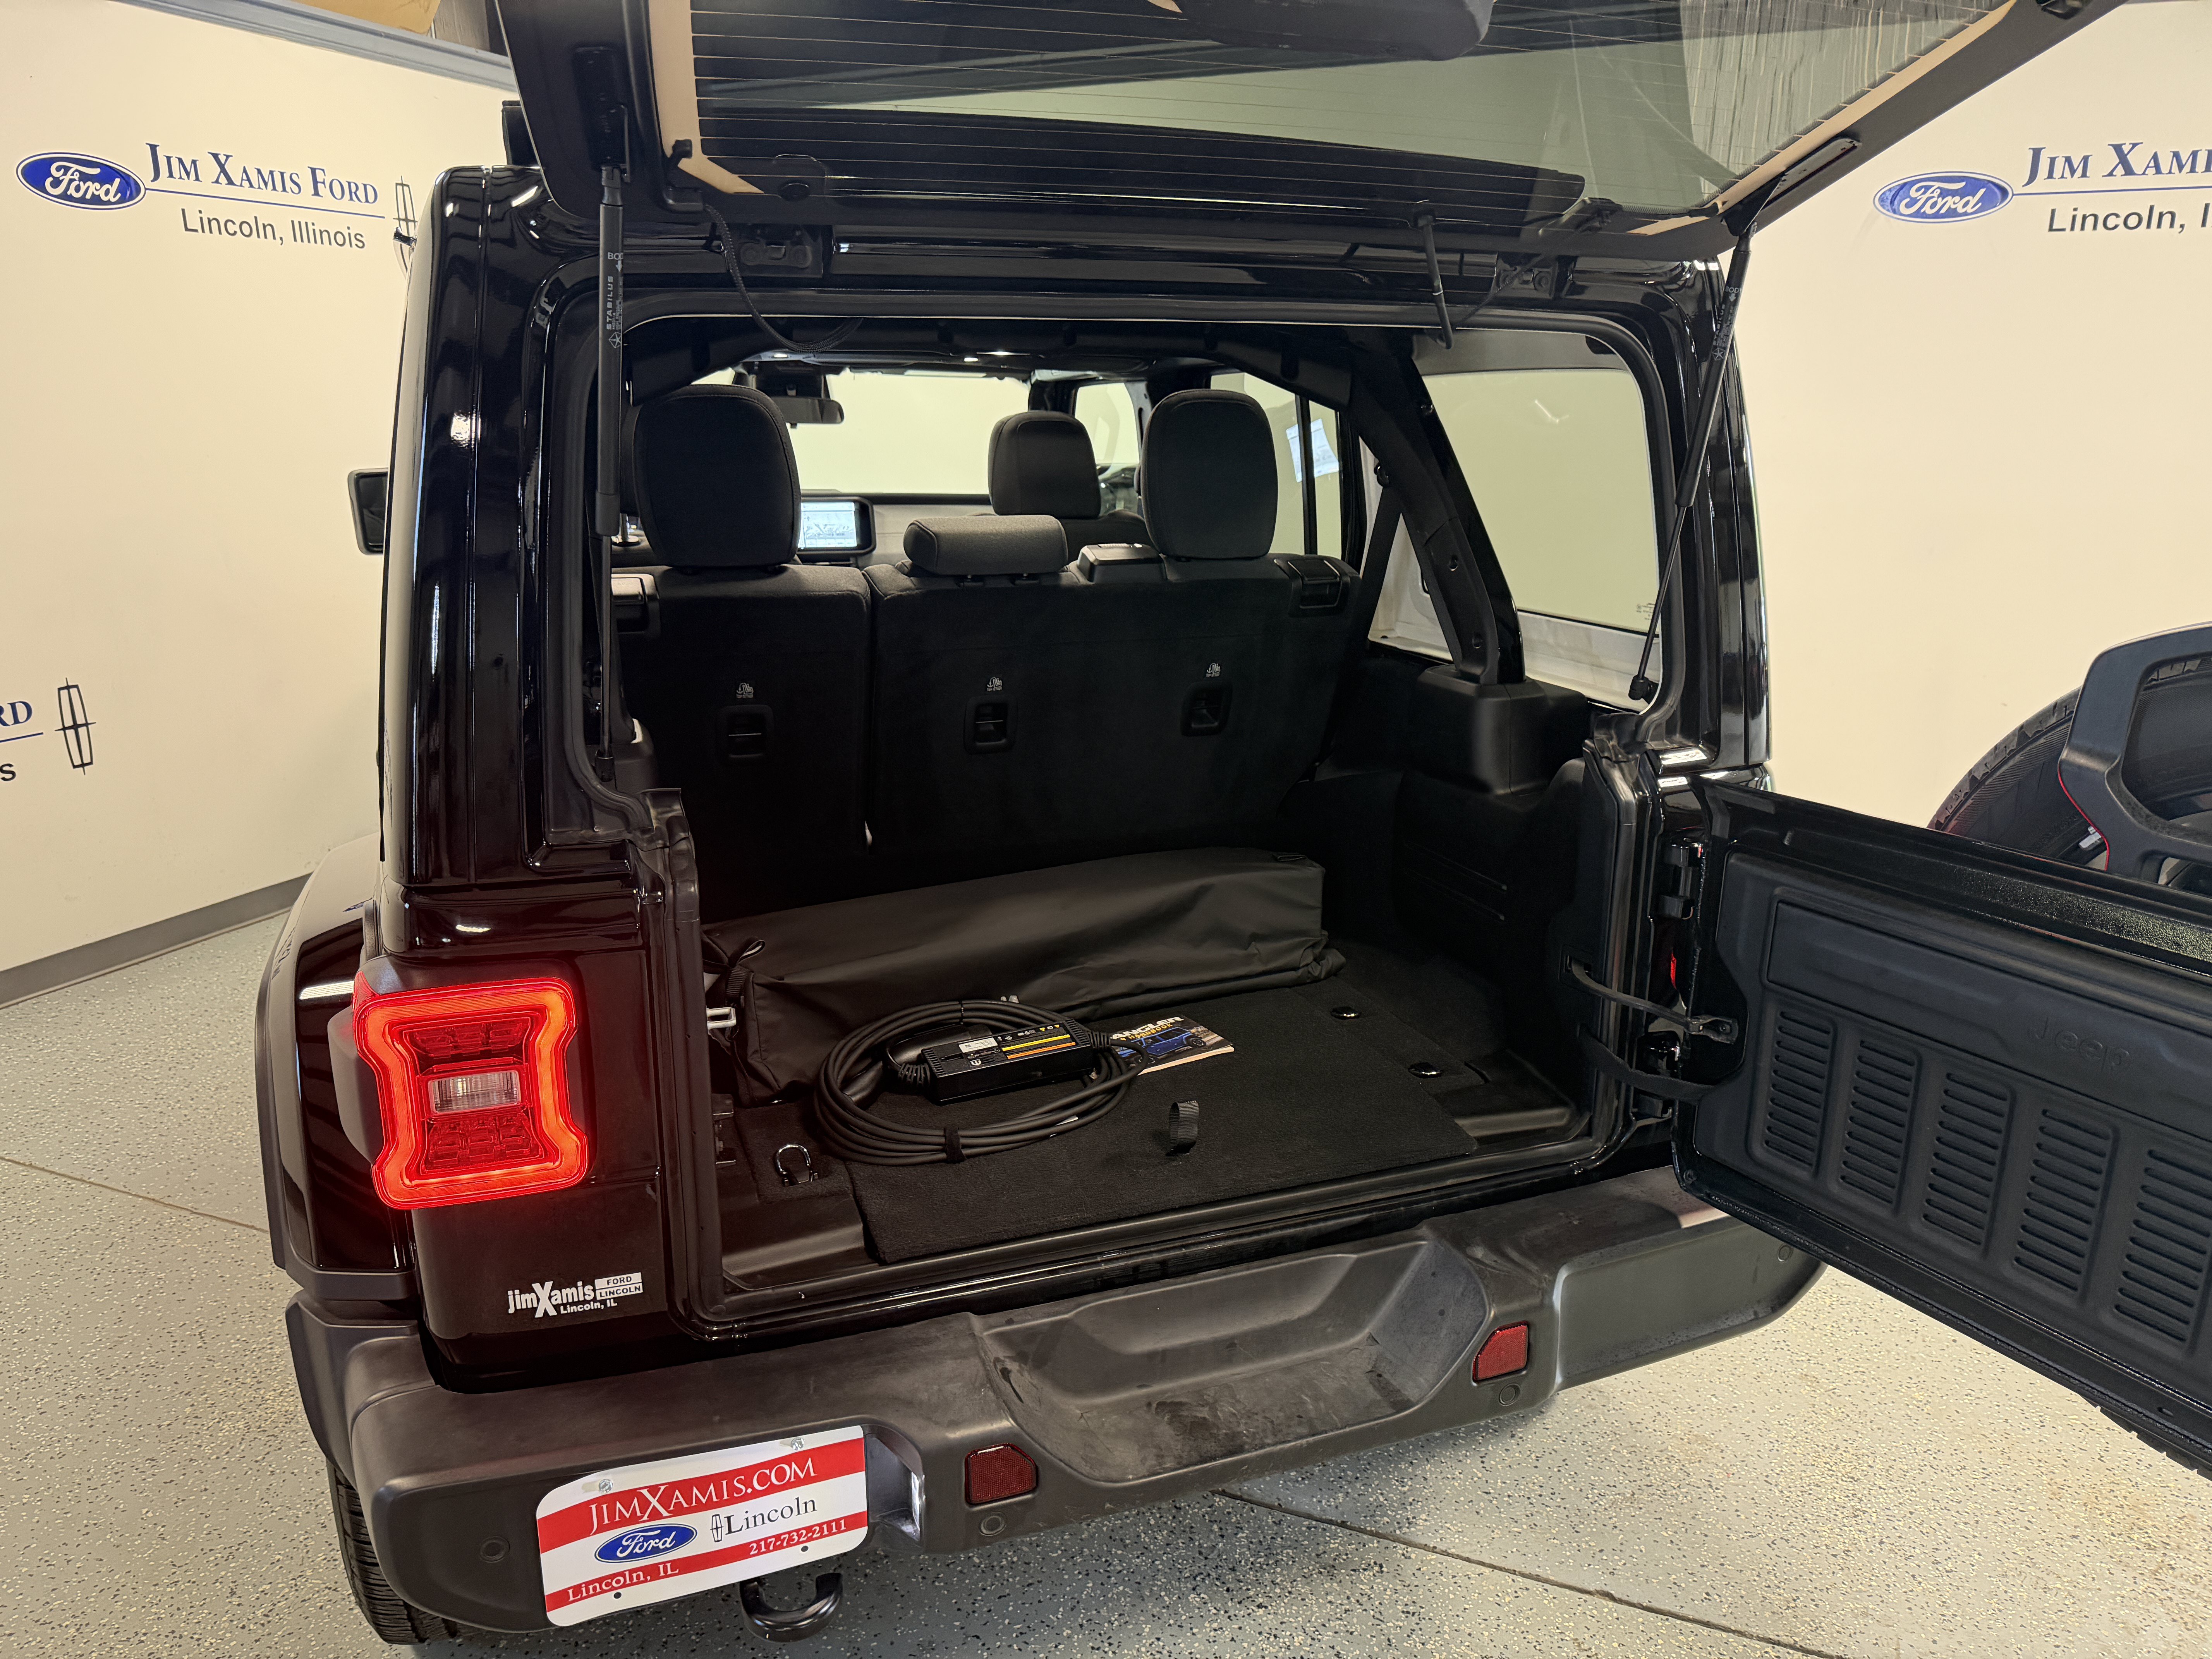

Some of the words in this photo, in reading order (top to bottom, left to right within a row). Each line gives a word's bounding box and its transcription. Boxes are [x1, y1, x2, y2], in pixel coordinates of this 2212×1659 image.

[45, 161, 121, 203] Ford
[1899, 180, 1987, 215] Ford
[181, 208, 283, 246] Lincoln,
[290, 220, 366, 249] Illinois
[2048, 204, 2186, 234] Lincoln,
[1110, 1017, 1184, 1039] ANGLER
[599, 1285, 641, 1298] LINCOLN
[607, 1276, 632, 1286] FORD
[560, 1301, 604, 1314] Lincoln,
[607, 1299, 617, 1307] IL
[725, 1496, 818, 1536] Lincoln
[617, 1528, 675, 1558] Ford
[749, 1518, 847, 1556] 217-732-2111
[567, 1571, 651, 1602] Lincoln,
[658, 1563, 679, 1577] IL
